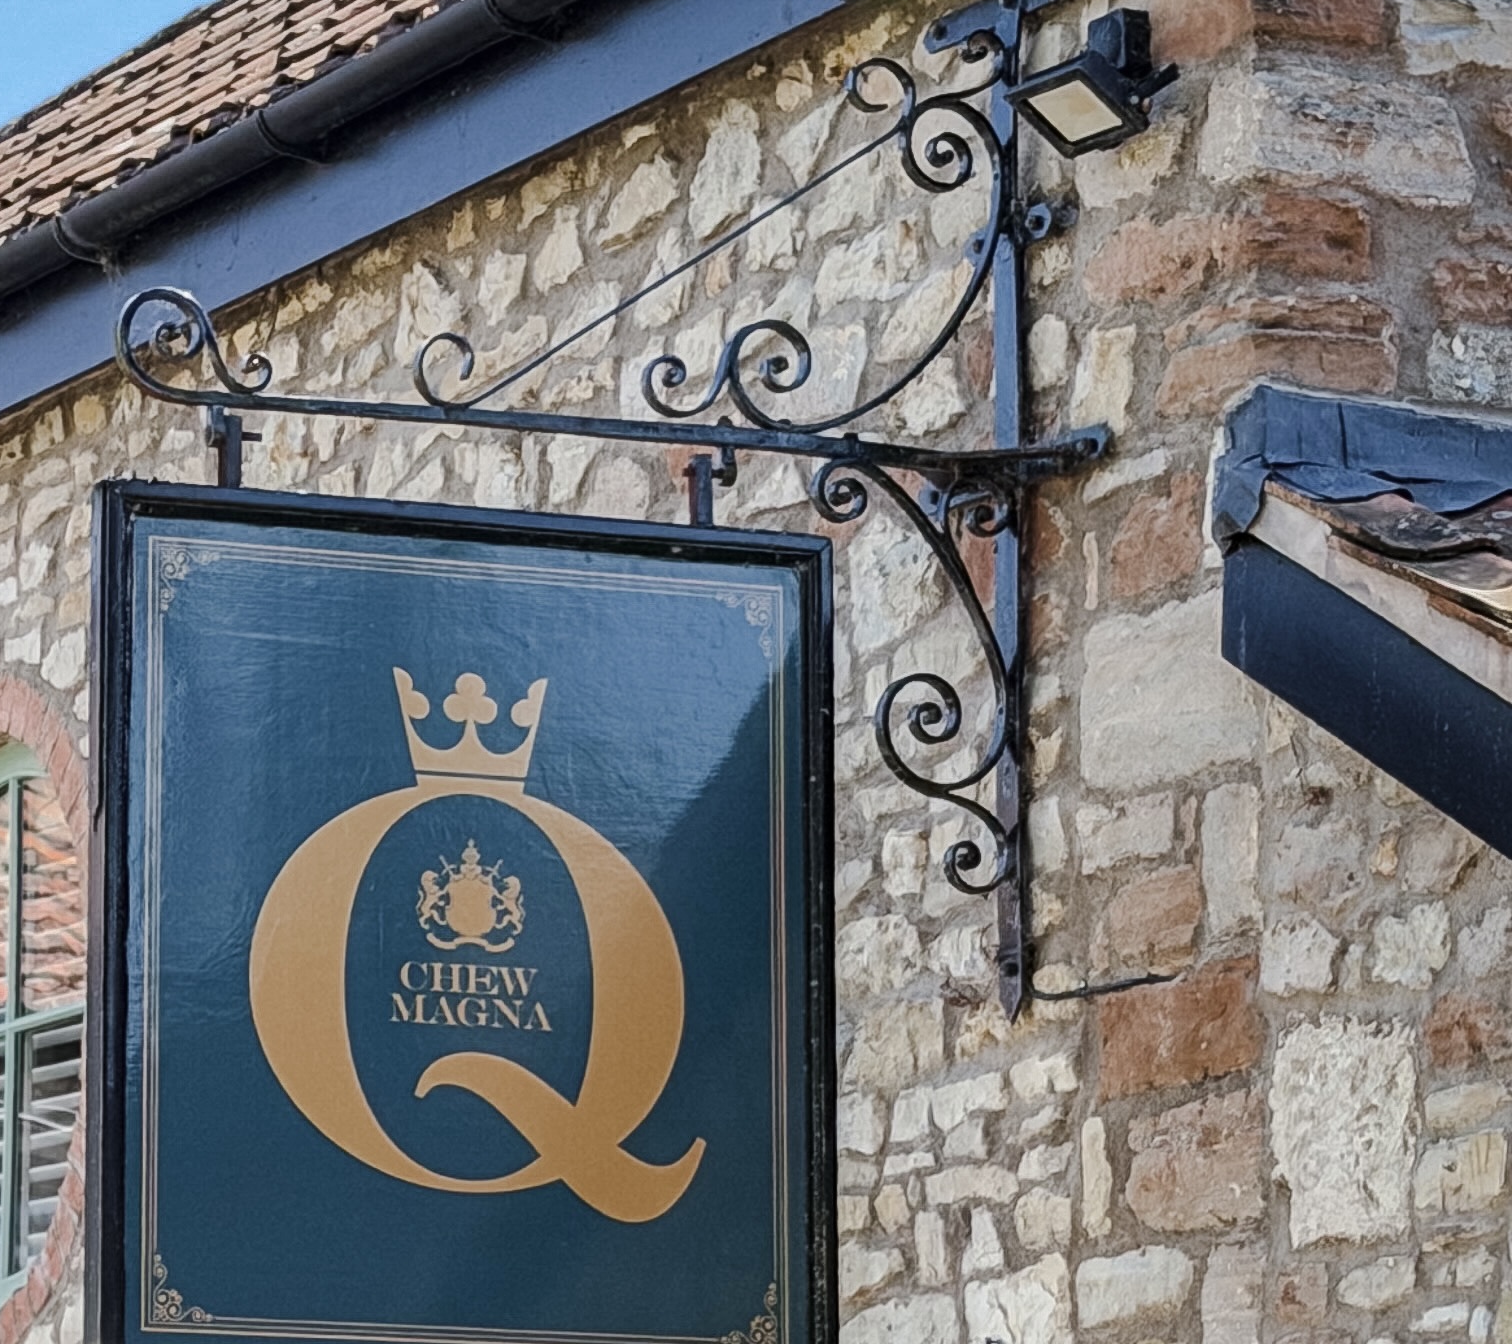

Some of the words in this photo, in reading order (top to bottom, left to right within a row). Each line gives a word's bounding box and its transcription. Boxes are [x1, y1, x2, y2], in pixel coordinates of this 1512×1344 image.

[400, 961, 539, 997] CHEW
[249, 785, 707, 1222] Q
[389, 992, 553, 1032] MAGNA
